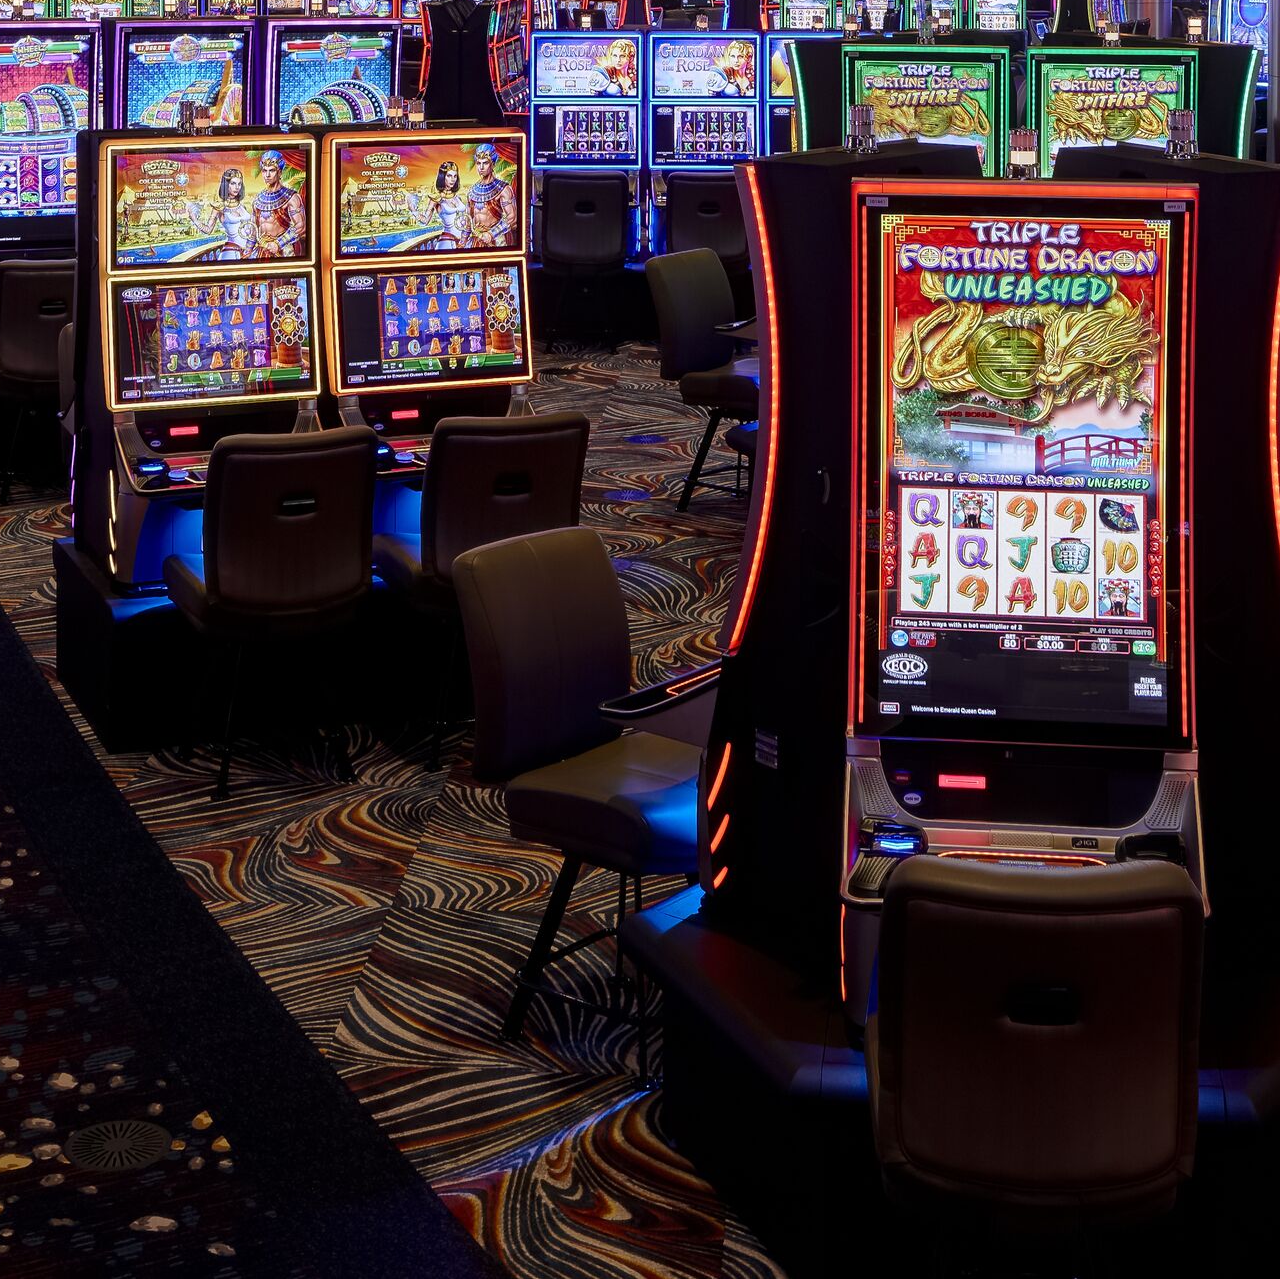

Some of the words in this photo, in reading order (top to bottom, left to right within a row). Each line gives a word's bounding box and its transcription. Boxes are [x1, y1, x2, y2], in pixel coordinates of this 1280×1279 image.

[541, 43, 608, 58] GUARDIAN
[658, 43, 726, 58] GUARDIAN
[558, 59, 592, 72] ROSE
[676, 59, 710, 73] ROSE
[898, 64, 953, 76] TRIPLE
[1086, 67, 1141, 79] TRIPLE
[864, 75, 927, 90] FORTUNE
[930, 75, 990, 90] DRAGON
[1050, 79, 1116, 92] FORTUNE
[1118, 79, 1179, 93] DRAGON
[888, 89, 961, 107] SPITFIRE
[1076, 91, 1149, 110] SPITFIRE
[365, 155, 399, 163] ROYALS
[143, 161, 180, 172] ROYALS
[358, 182, 406, 190] SURROUNDING
[135, 190, 187, 198] SURROUNDING
[969, 221, 1081, 245] TRIPLE
[899, 243, 1030, 271] FORTUNE
[1036, 245, 1158, 273] DRAGON
[943, 272, 1112, 305] UNLEASHED
[898, 470, 954, 482] TRIPLE
[957, 472, 1024, 486] FORTUNE
[1026, 474, 1085, 487] DRAGON
[1087, 477, 1150, 490] UNLEASHED
[883, 545, 897, 587] WAYS
[1149, 554, 1162, 597] WAYS
[895, 620, 918, 628] Playing
[979, 622, 1010, 631] multiplier
[1004, 640, 1017, 648] 50
[1037, 640, 1064, 649] $0.00
[1137, 643, 1151, 652] 1¢
[890, 660, 924, 672] EQC
[1134, 689, 1150, 697] PLAYER
[1149, 683, 1162, 691] YOUR
[940, 706, 960, 714] Emerald
[977, 708, 996, 716] Casino!
